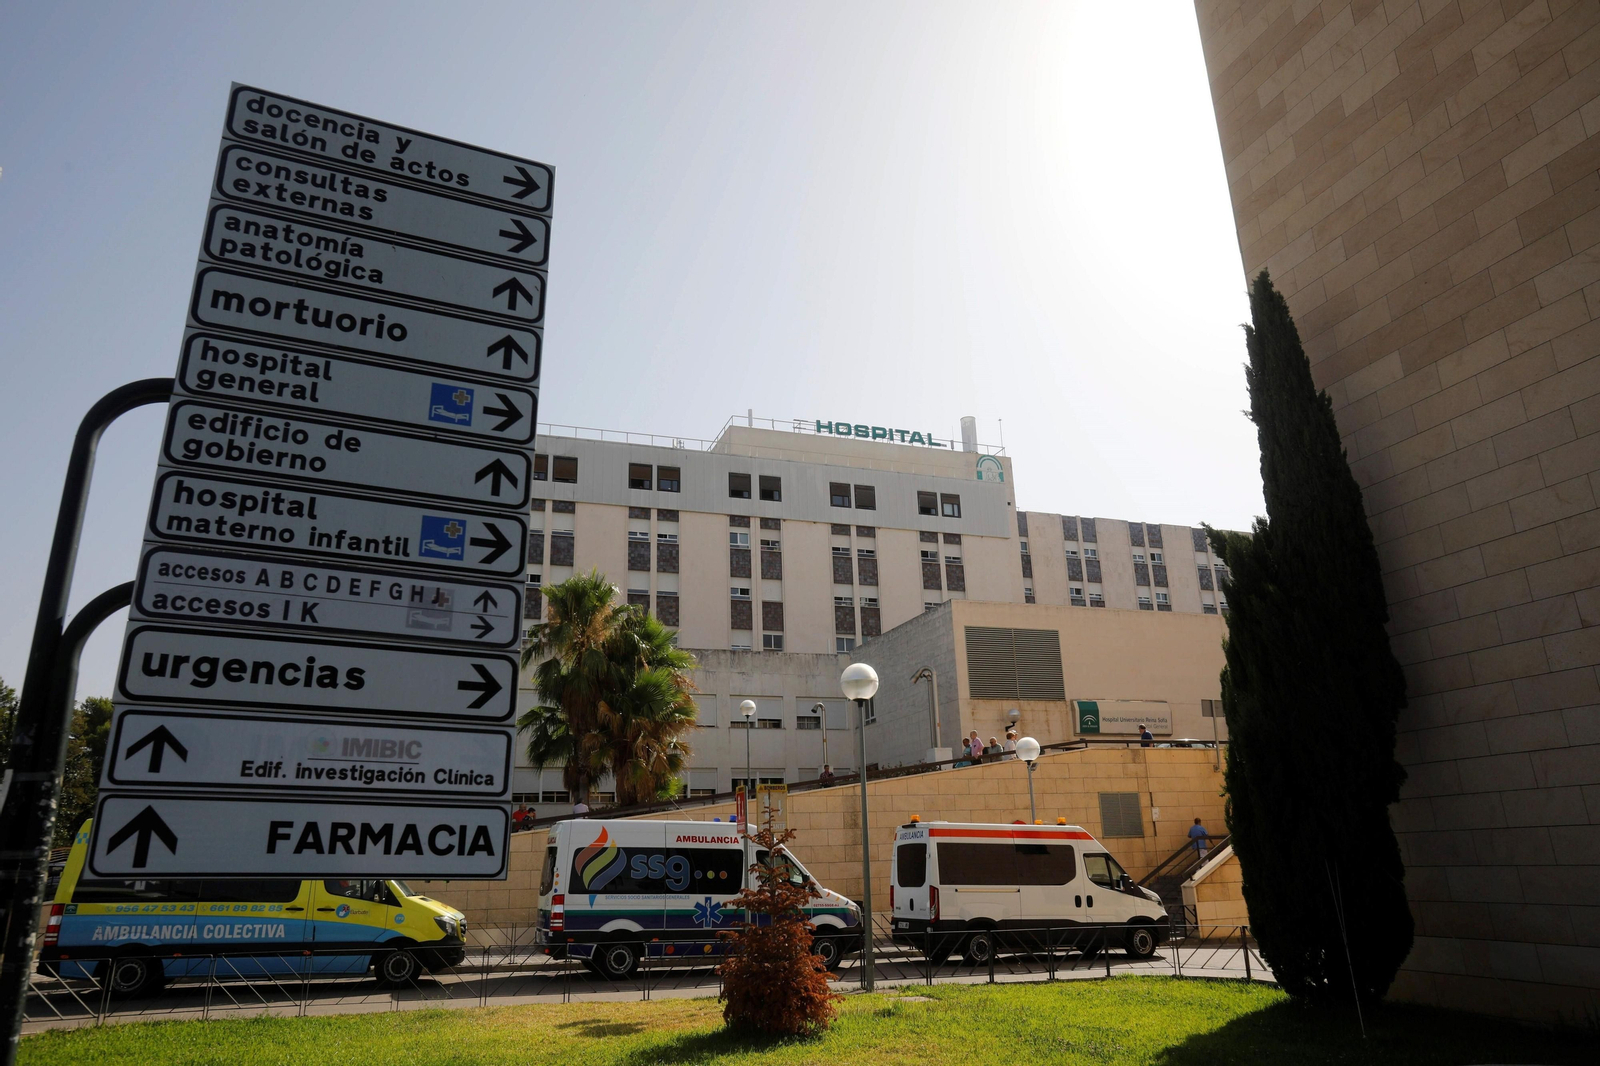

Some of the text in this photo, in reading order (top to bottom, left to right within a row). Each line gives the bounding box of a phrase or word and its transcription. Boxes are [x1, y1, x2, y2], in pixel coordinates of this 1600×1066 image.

[246, 96, 412, 154] docencia y
[243, 118, 470, 187] salón de actos
[235, 156, 388, 203] consultas
[233, 178, 374, 221] externas
[224, 216, 364, 259] anatomía
[219, 238, 384, 284] patológica
[210, 288, 408, 342] mortuorio
[200, 340, 332, 381] hospital
[196, 368, 319, 403] general
[187, 411, 361, 453] edificio de
[816, 419, 941, 447] HOSPITAL
[182, 438, 327, 473] gobierno
[173, 479, 318, 520] hospital
[166, 512, 410, 557] materno infantil
[158, 561, 246, 584] accesos
[255, 568, 271, 587] A
[280, 571, 294, 588] B
[303, 573, 318, 591] C
[326, 576, 341, 593] D
[349, 578, 361, 595] E
[370, 580, 381, 597] F
[389, 582, 402, 600] G
[411, 585, 424, 603] H
[152, 592, 319, 623] accesos I K
[141, 651, 366, 691] urgencias
[1102, 716, 1119, 724] Hospital
[342, 736, 422, 760] IMIBIC
[240, 760, 494, 786] Edif. investigación Clínica
[266, 820, 496, 857] FARMACIA
[676, 834, 740, 844] AMBULANCIA
[630, 854, 690, 891] ssg
[115, 904, 195, 912] 956 47 53 43
[210, 904, 284, 912] 661 89 82 85
[92, 923, 286, 941] AMBULANCIA COLECTIVA
